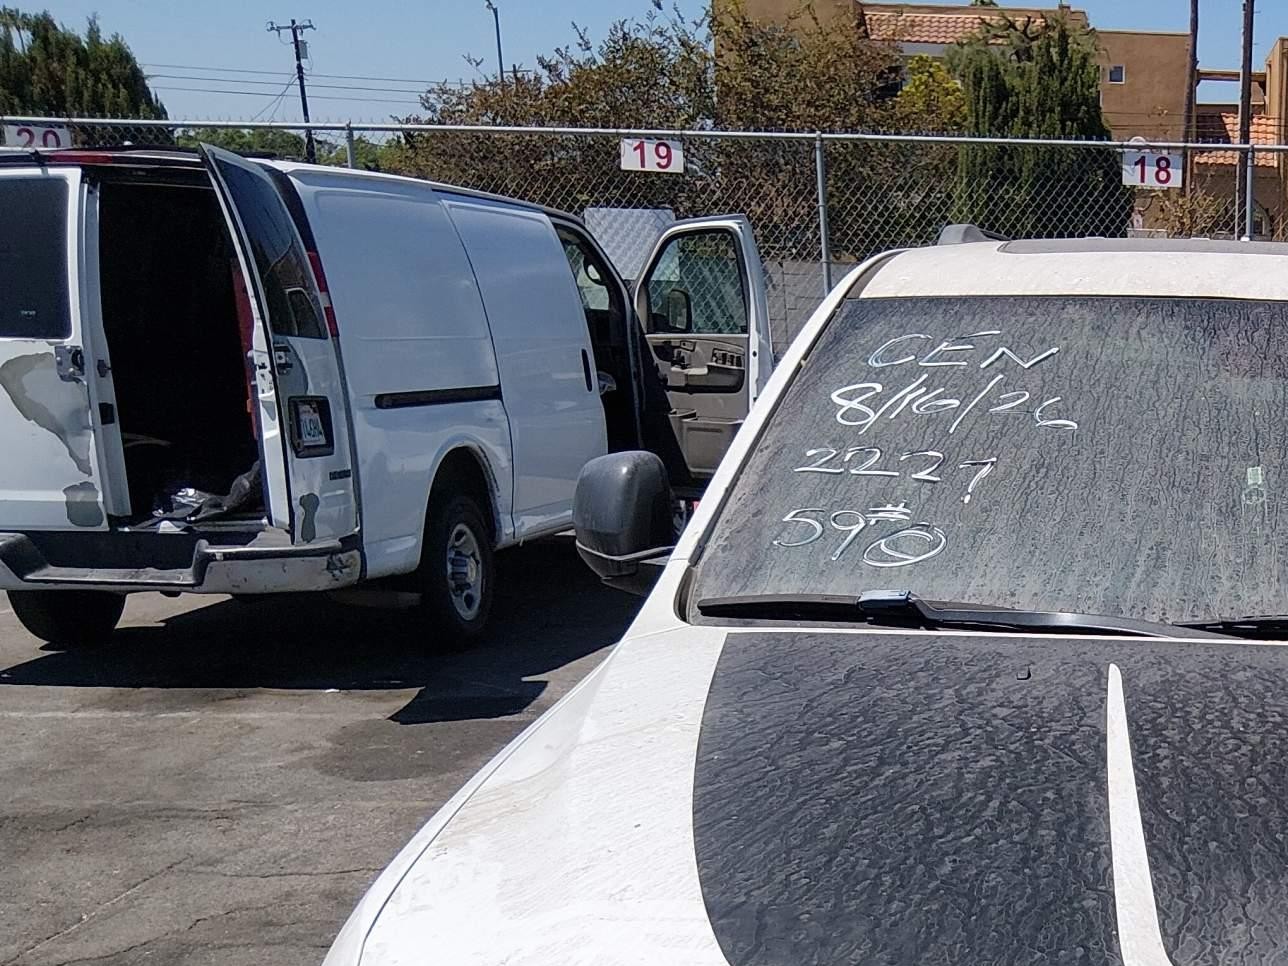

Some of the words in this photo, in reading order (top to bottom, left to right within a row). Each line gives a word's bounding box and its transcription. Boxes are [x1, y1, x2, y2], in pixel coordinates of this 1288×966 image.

[16, 127, 62, 148] 20
[632, 140, 673, 170] 19
[1134, 155, 1172, 185] 18
[867, 330, 1061, 369] CEN
[793, 446, 998, 503] 2227
